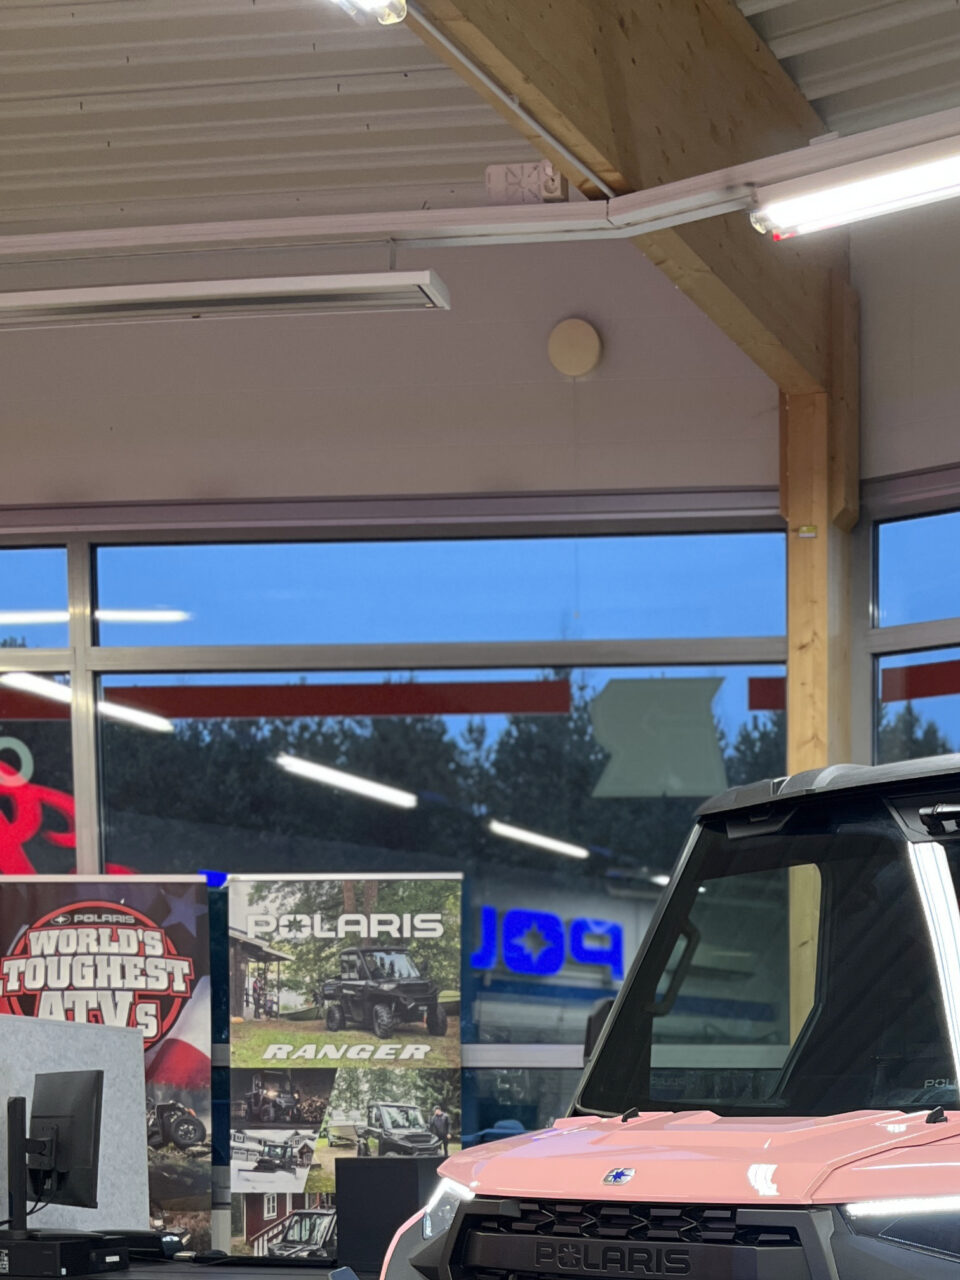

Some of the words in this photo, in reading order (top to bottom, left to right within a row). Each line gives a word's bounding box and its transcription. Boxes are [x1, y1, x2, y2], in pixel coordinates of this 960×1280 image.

[74, 914, 135, 923] POLARIS
[247, 913, 444, 938] POLARIS
[29, 928, 164, 956] WORLD'S
[3, 956, 190, 992] TOUGHEST
[263, 1044, 431, 1059] RANGER
[535, 1241, 691, 1276] POLARIS
